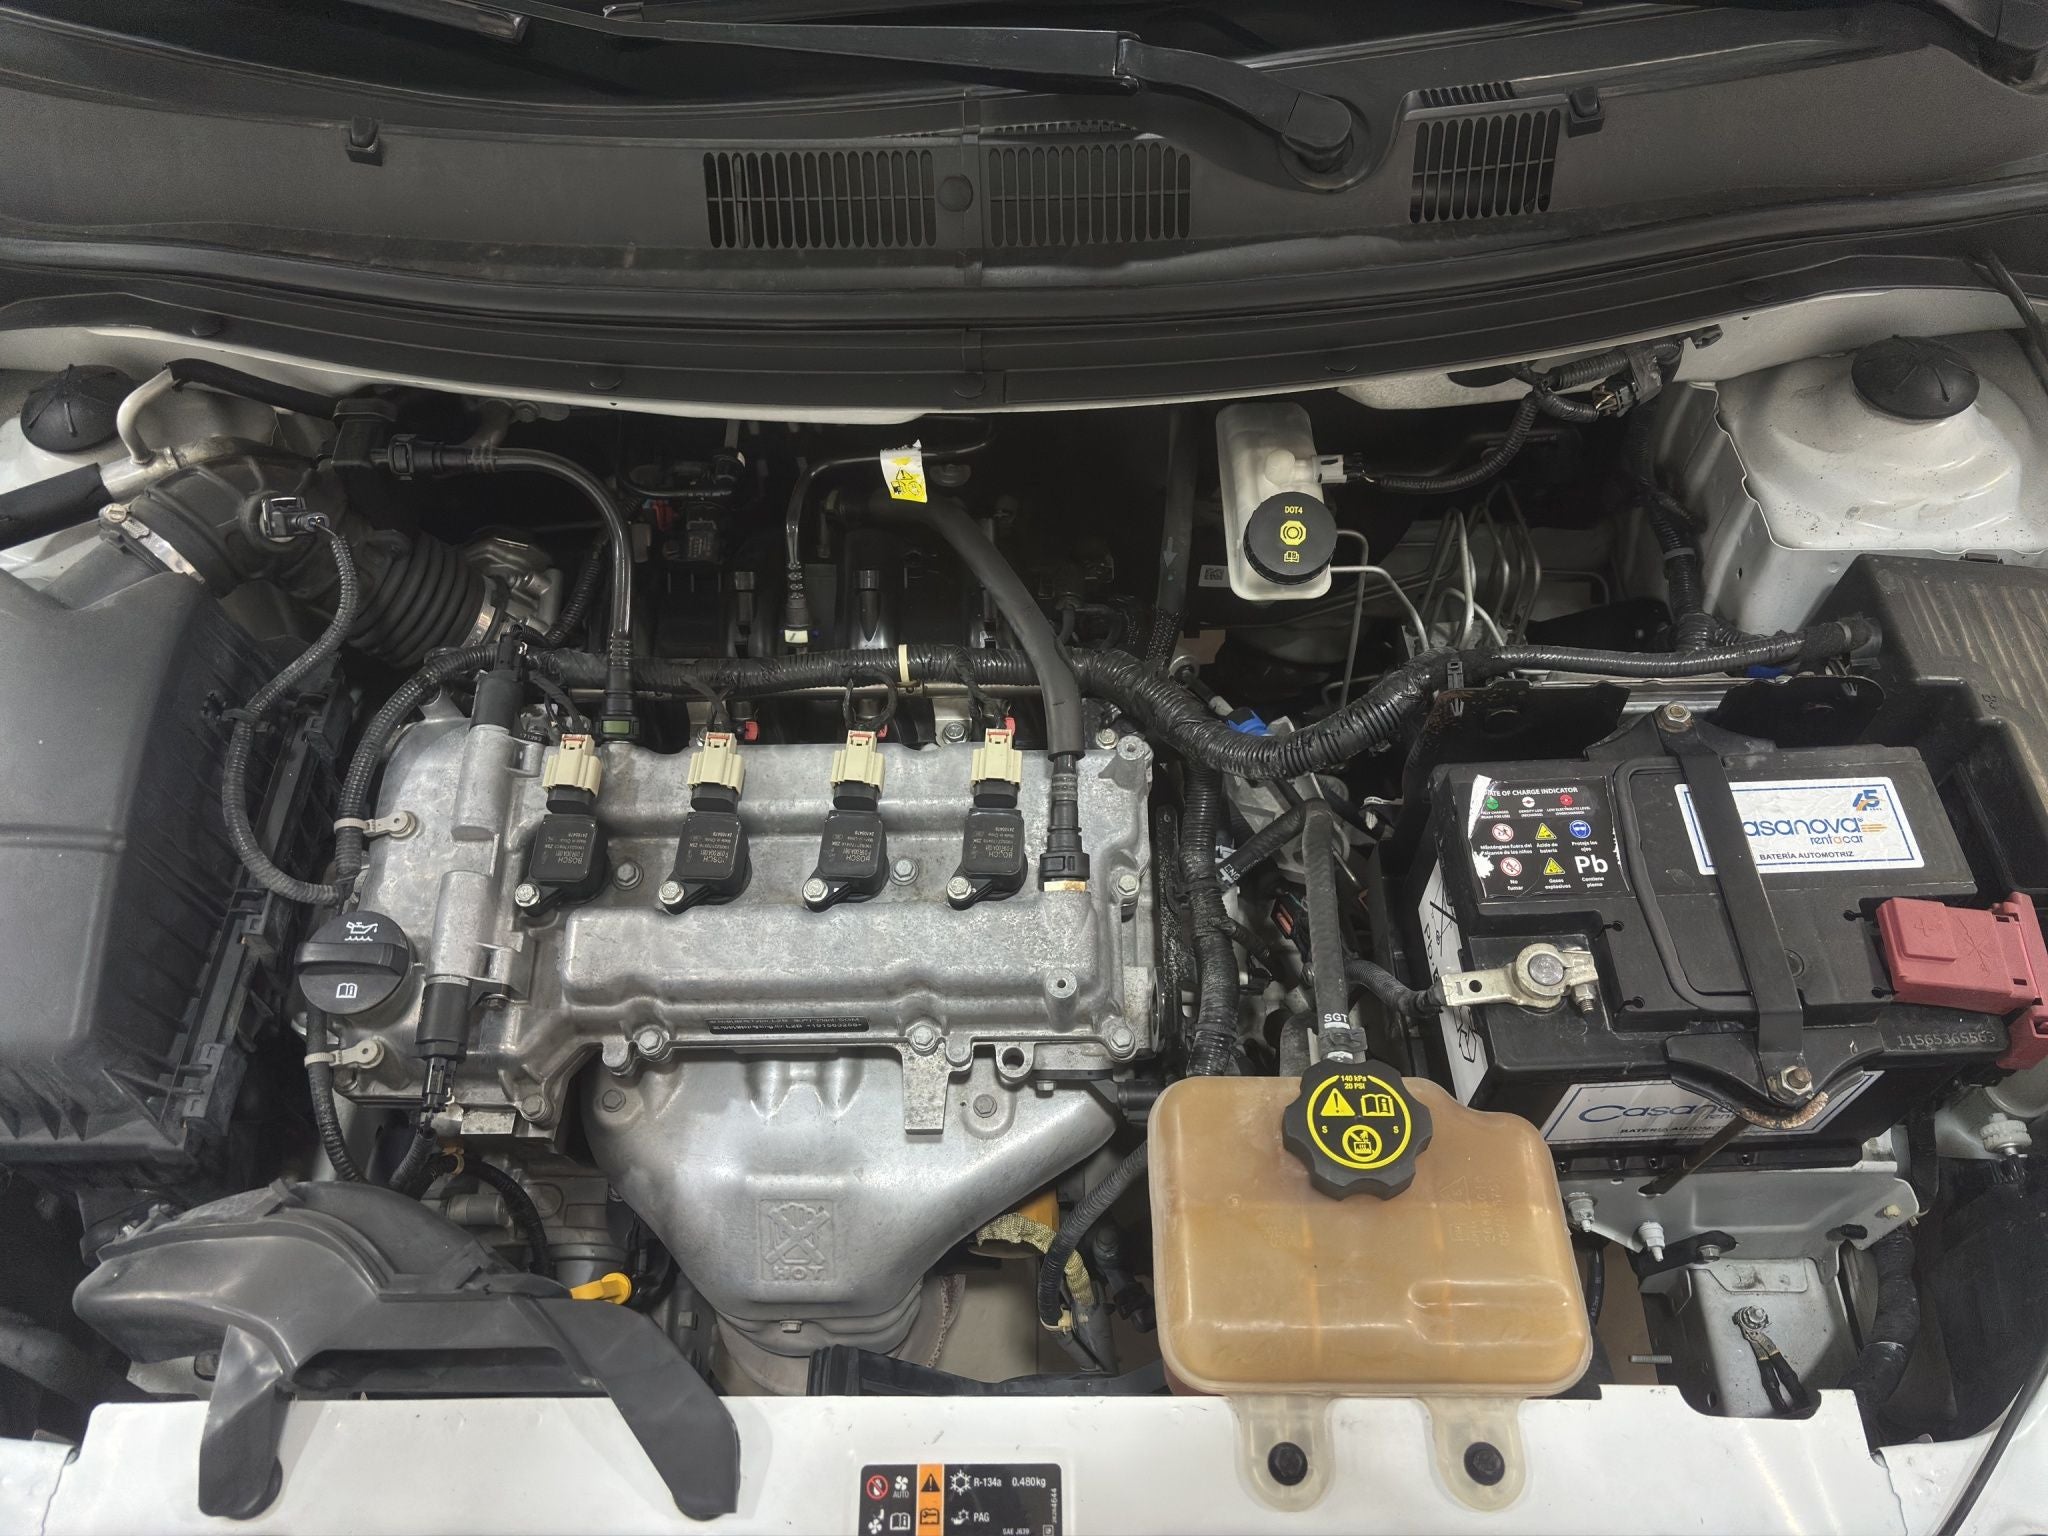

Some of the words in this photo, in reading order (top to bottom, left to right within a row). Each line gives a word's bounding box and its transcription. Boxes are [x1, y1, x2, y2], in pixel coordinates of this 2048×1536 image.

[1284, 506, 1303, 514] DOT4
[1541, 787, 1578, 795] INDICATOR
[1743, 817, 1861, 837] asanova
[988, 850, 1013, 859] BOSCH
[1760, 851, 1796, 861] BATERÍA
[1798, 851, 1855, 859] AUTOMOTRIZ
[557, 857, 583, 865] BOSCH
[1574, 854, 1608, 874] Pb
[1324, 1012, 1348, 1023] SGT
[1322, 1125, 1328, 1134] S
[1393, 1125, 1399, 1134] S
[973, 1477, 1002, 1487] R-134a
[893, 1490, 910, 1498] AUTO
[973, 1512, 990, 1522] PAG
